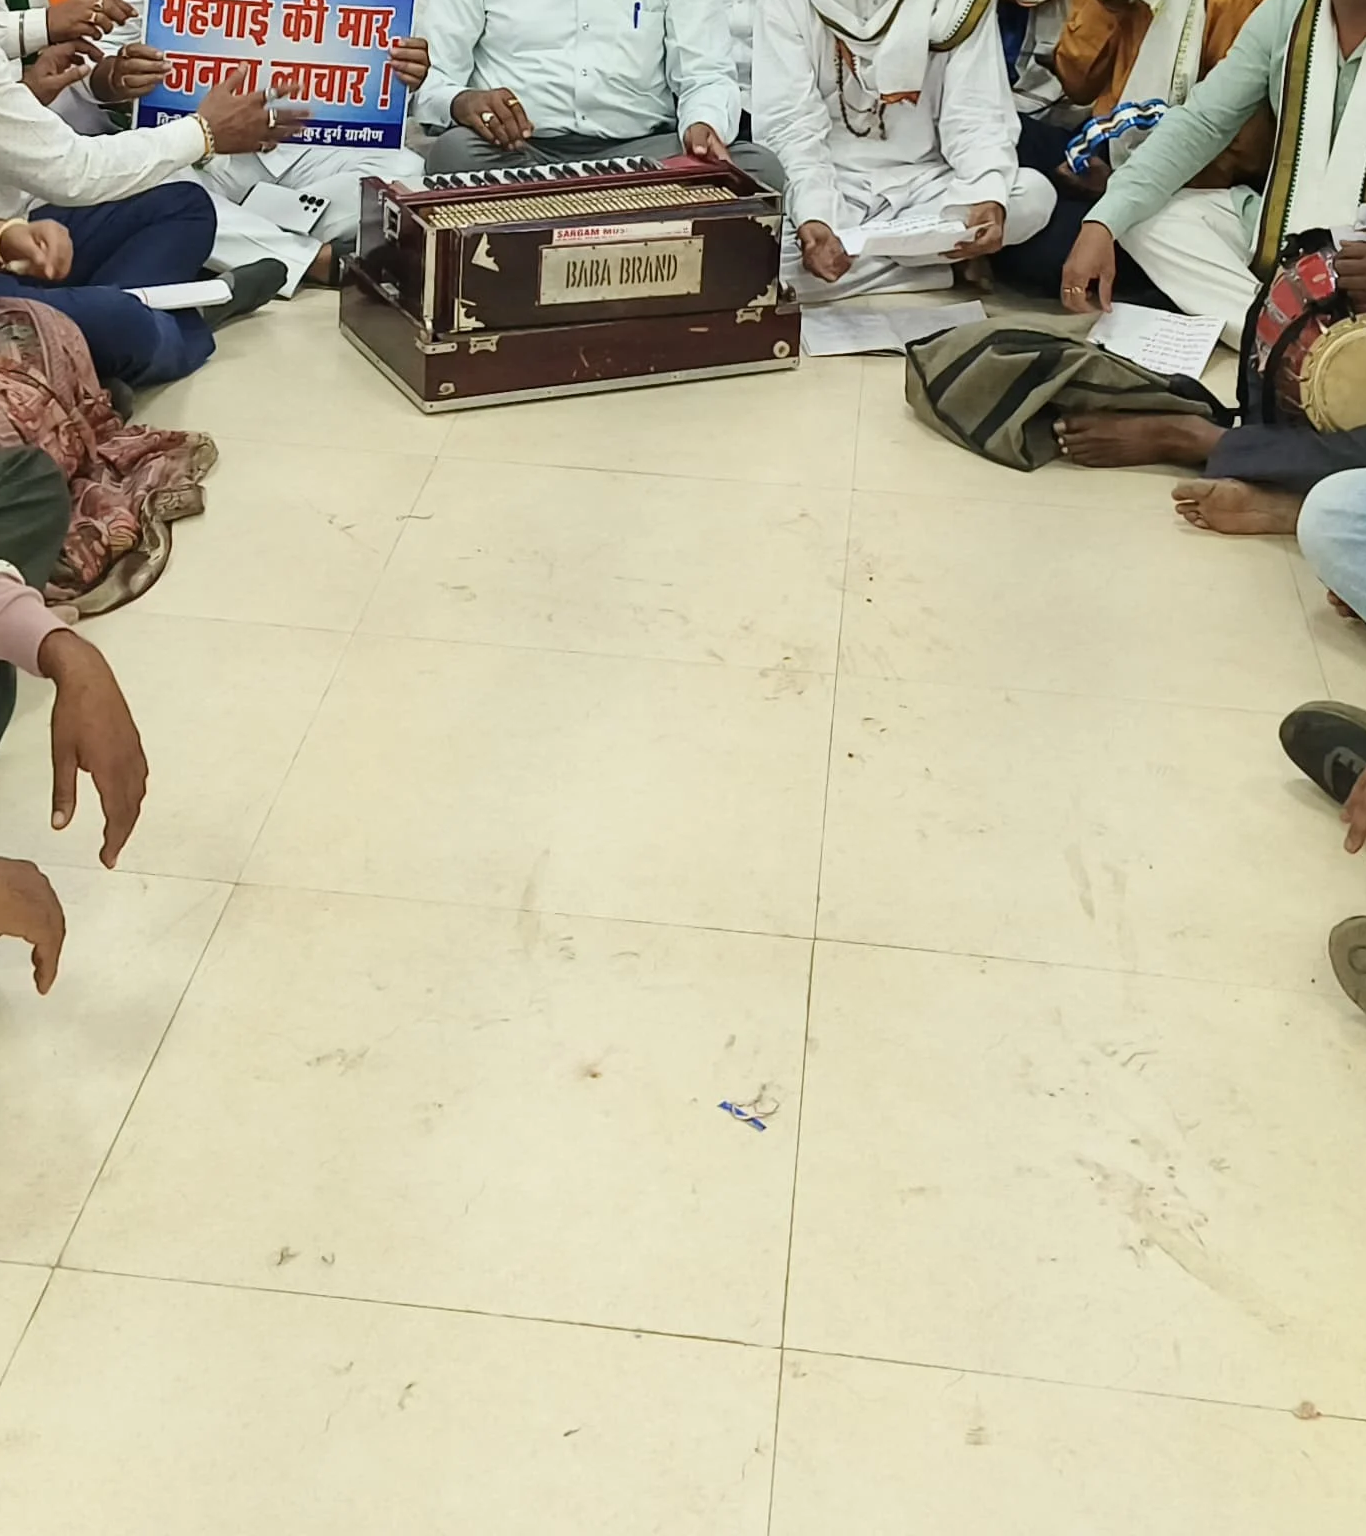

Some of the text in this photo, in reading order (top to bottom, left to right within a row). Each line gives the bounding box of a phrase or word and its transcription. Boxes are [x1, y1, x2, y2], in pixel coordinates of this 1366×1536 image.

[164, 53, 262, 96] जनता
[270, 61, 369, 106] लाचार
[324, 124, 341, 143] दुर्ग
[344, 126, 385, 143] ग्रामीण
[557, 227, 600, 239] SARGAM
[566, 253, 678, 289] BABA BRAND
